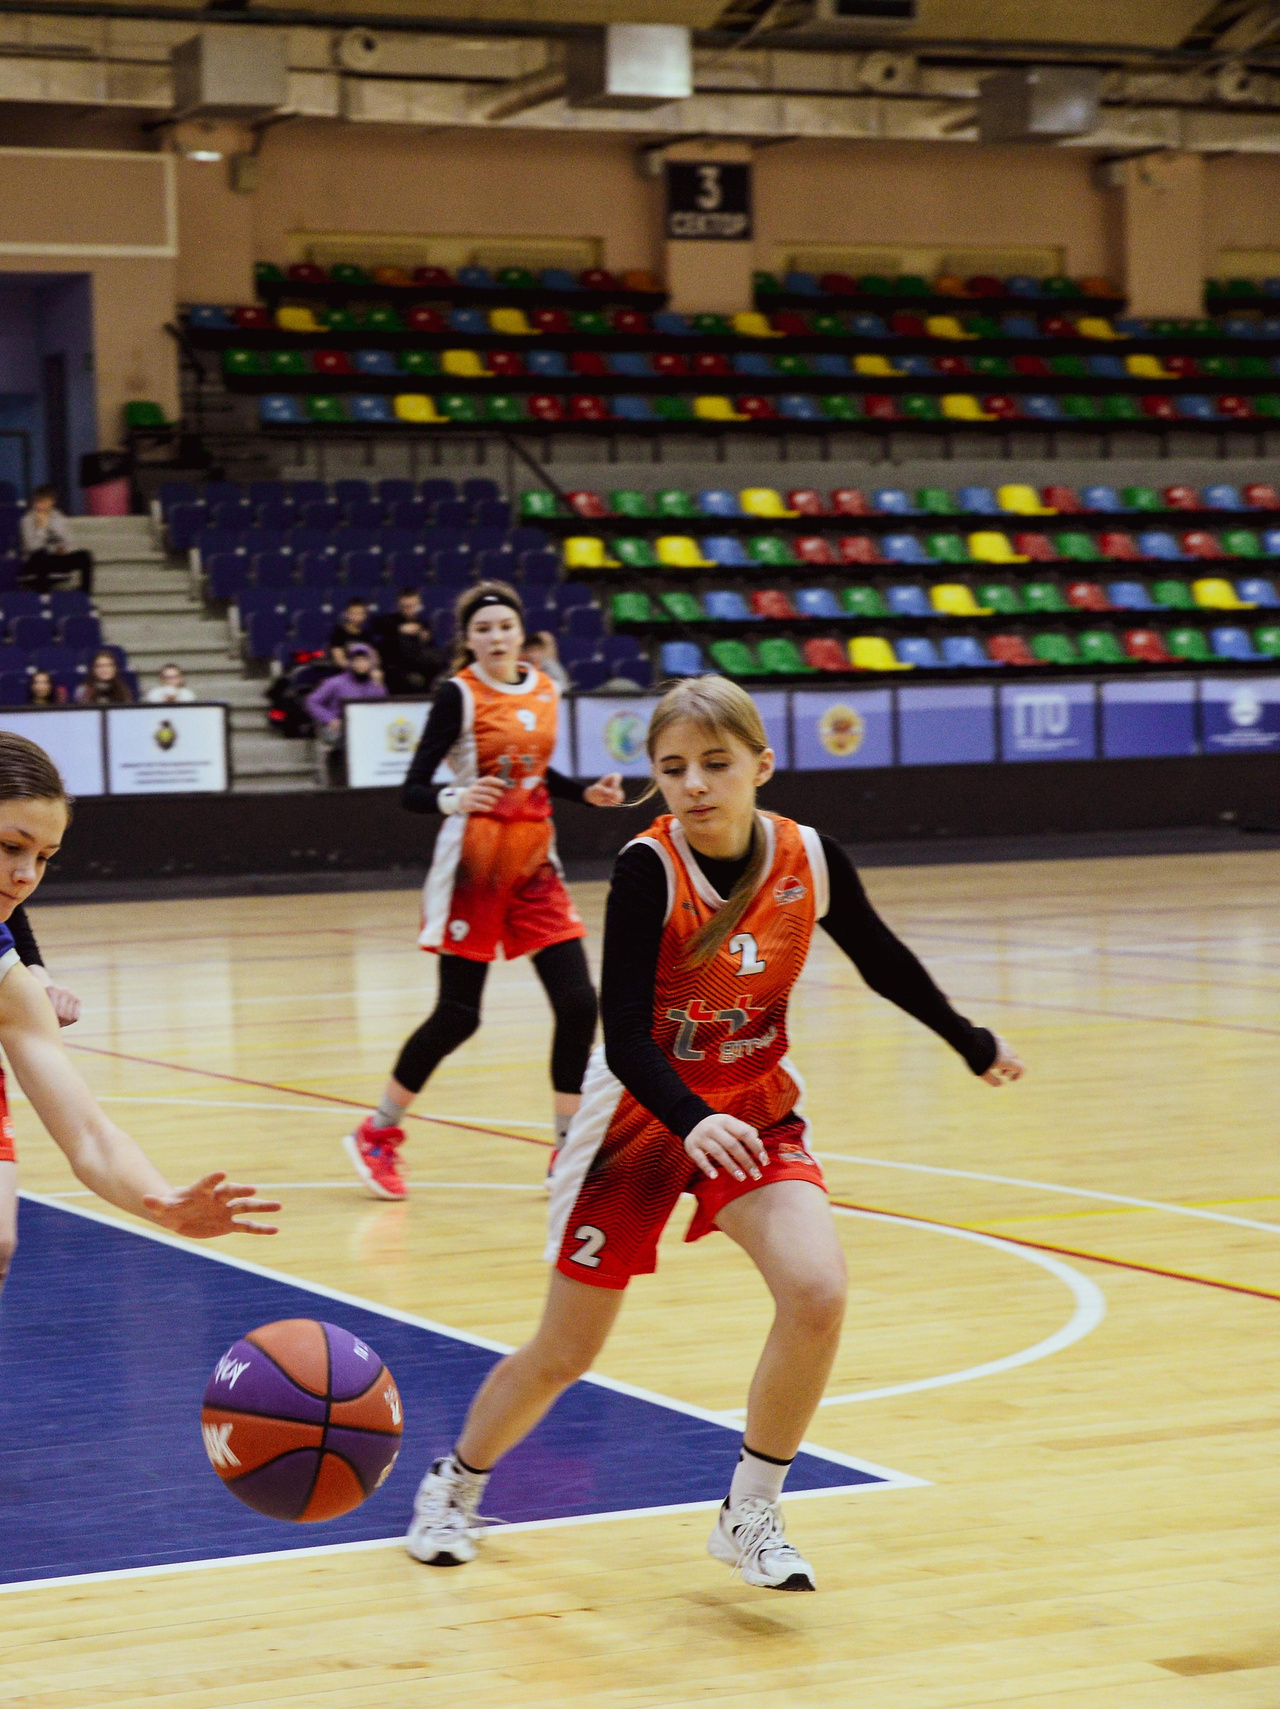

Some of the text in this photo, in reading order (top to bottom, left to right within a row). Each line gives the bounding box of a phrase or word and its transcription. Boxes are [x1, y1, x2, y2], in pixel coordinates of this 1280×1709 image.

[696, 165, 722, 210] 3
[516, 708, 538, 732] 9
[449, 918, 470, 943] 9
[728, 932, 767, 977] 2
[568, 1225, 607, 1269] 2
